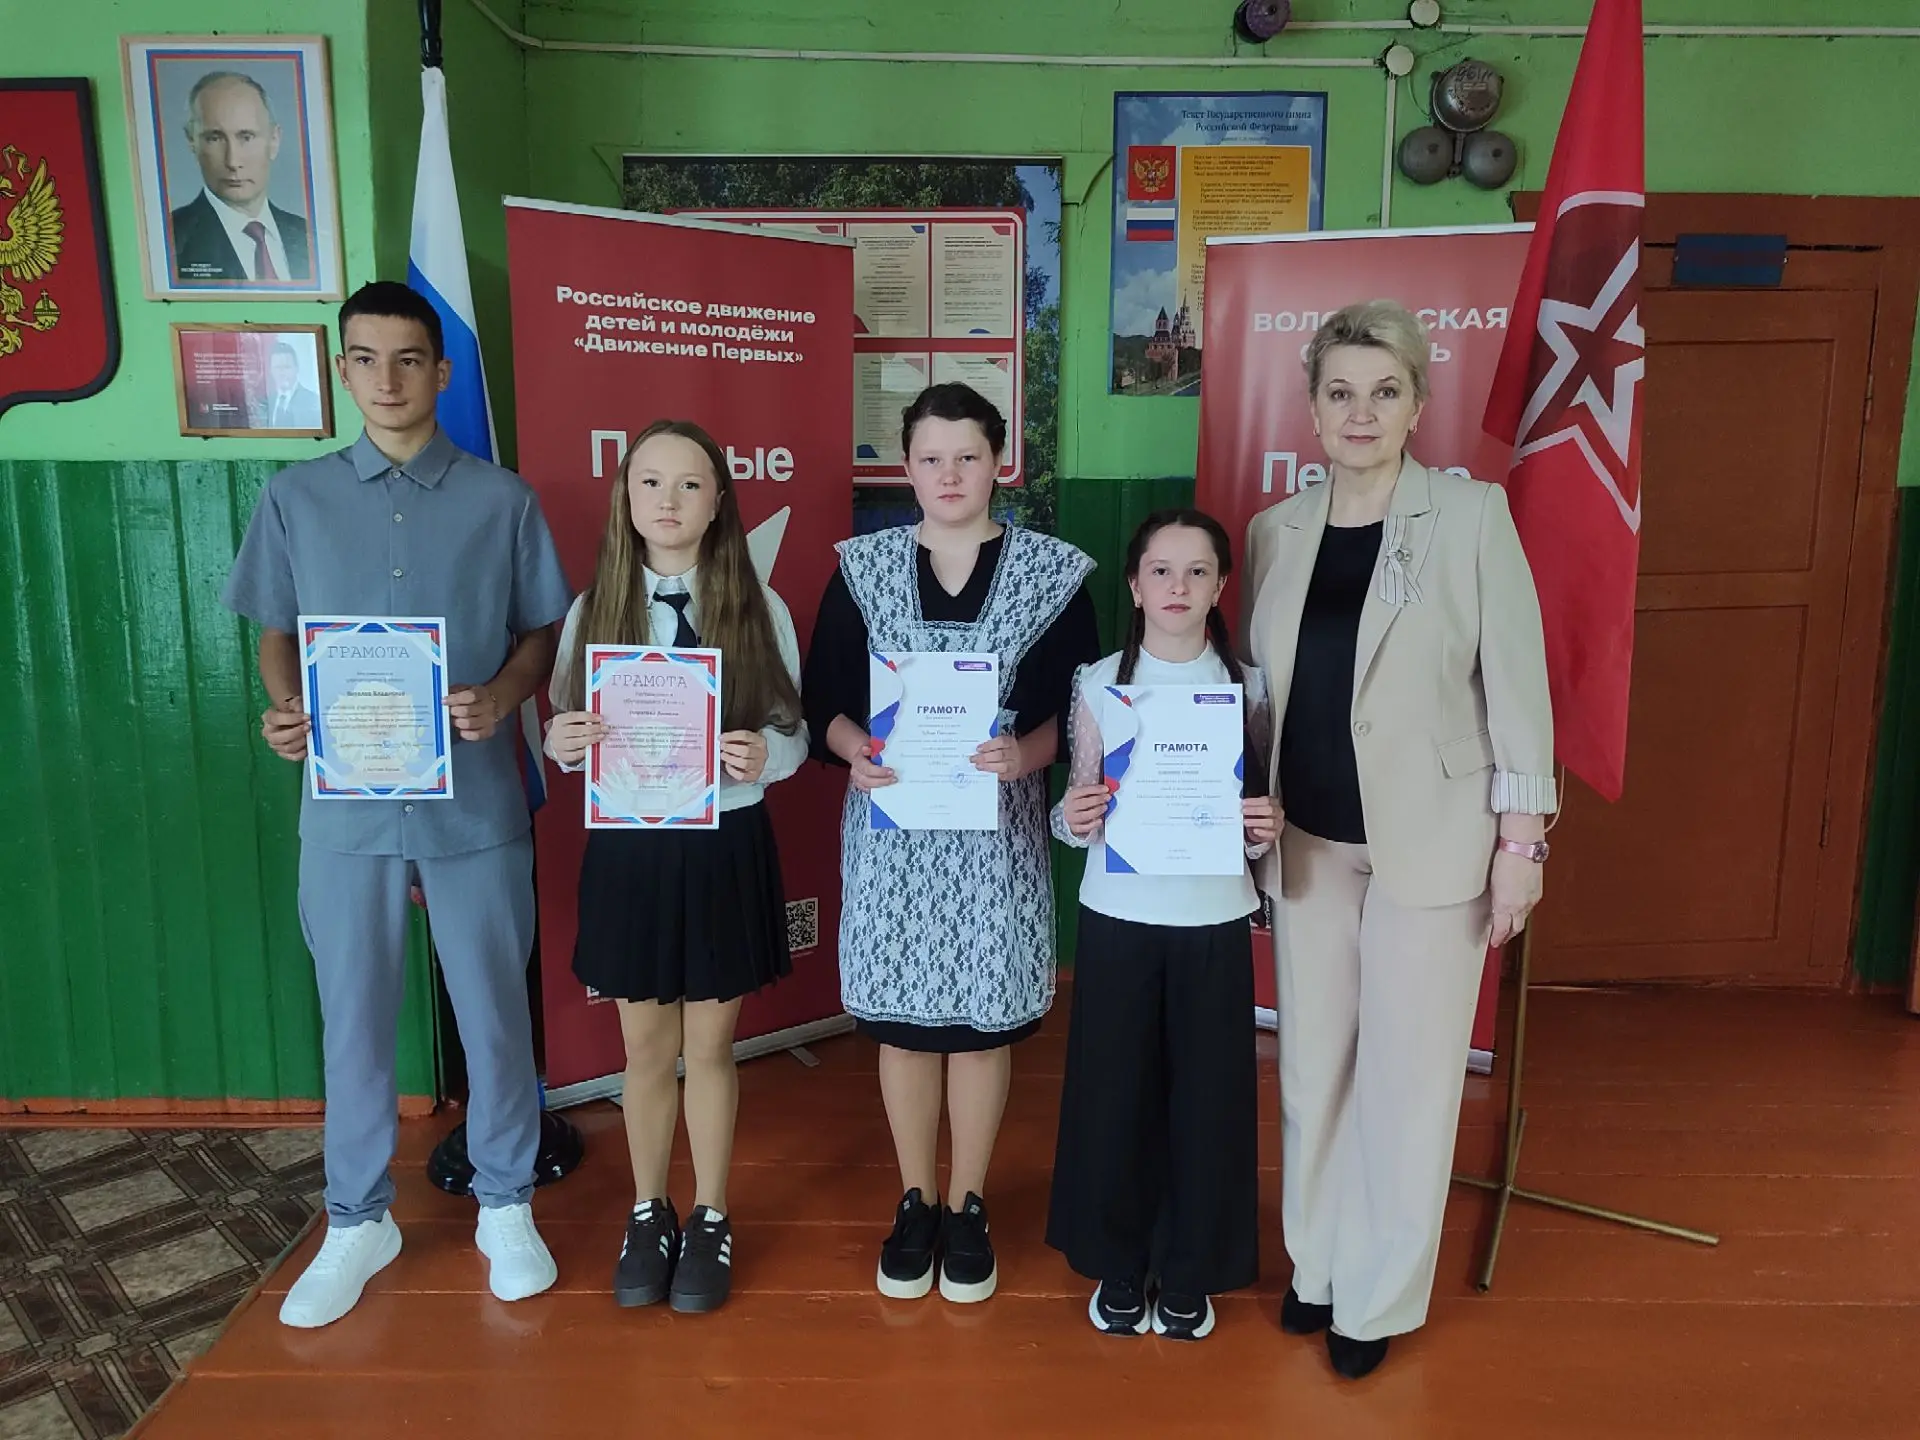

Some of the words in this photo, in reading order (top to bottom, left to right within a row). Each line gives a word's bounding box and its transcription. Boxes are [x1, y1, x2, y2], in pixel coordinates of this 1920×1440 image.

[556, 285, 702, 315] Российское
[706, 302, 816, 324] движение
[585, 314, 656, 332] детей
[661, 319, 676, 334] и
[680, 321, 794, 343] молодёжи
[574, 333, 708, 357] «Движение
[712, 342, 804, 364] Первых»
[327, 645, 410, 659] ГРАМОТА
[611, 674, 688, 688] ГРАМОТА
[916, 705, 967, 714] ГРАМОТА
[1153, 743, 1209, 752] ГРАМОТА
